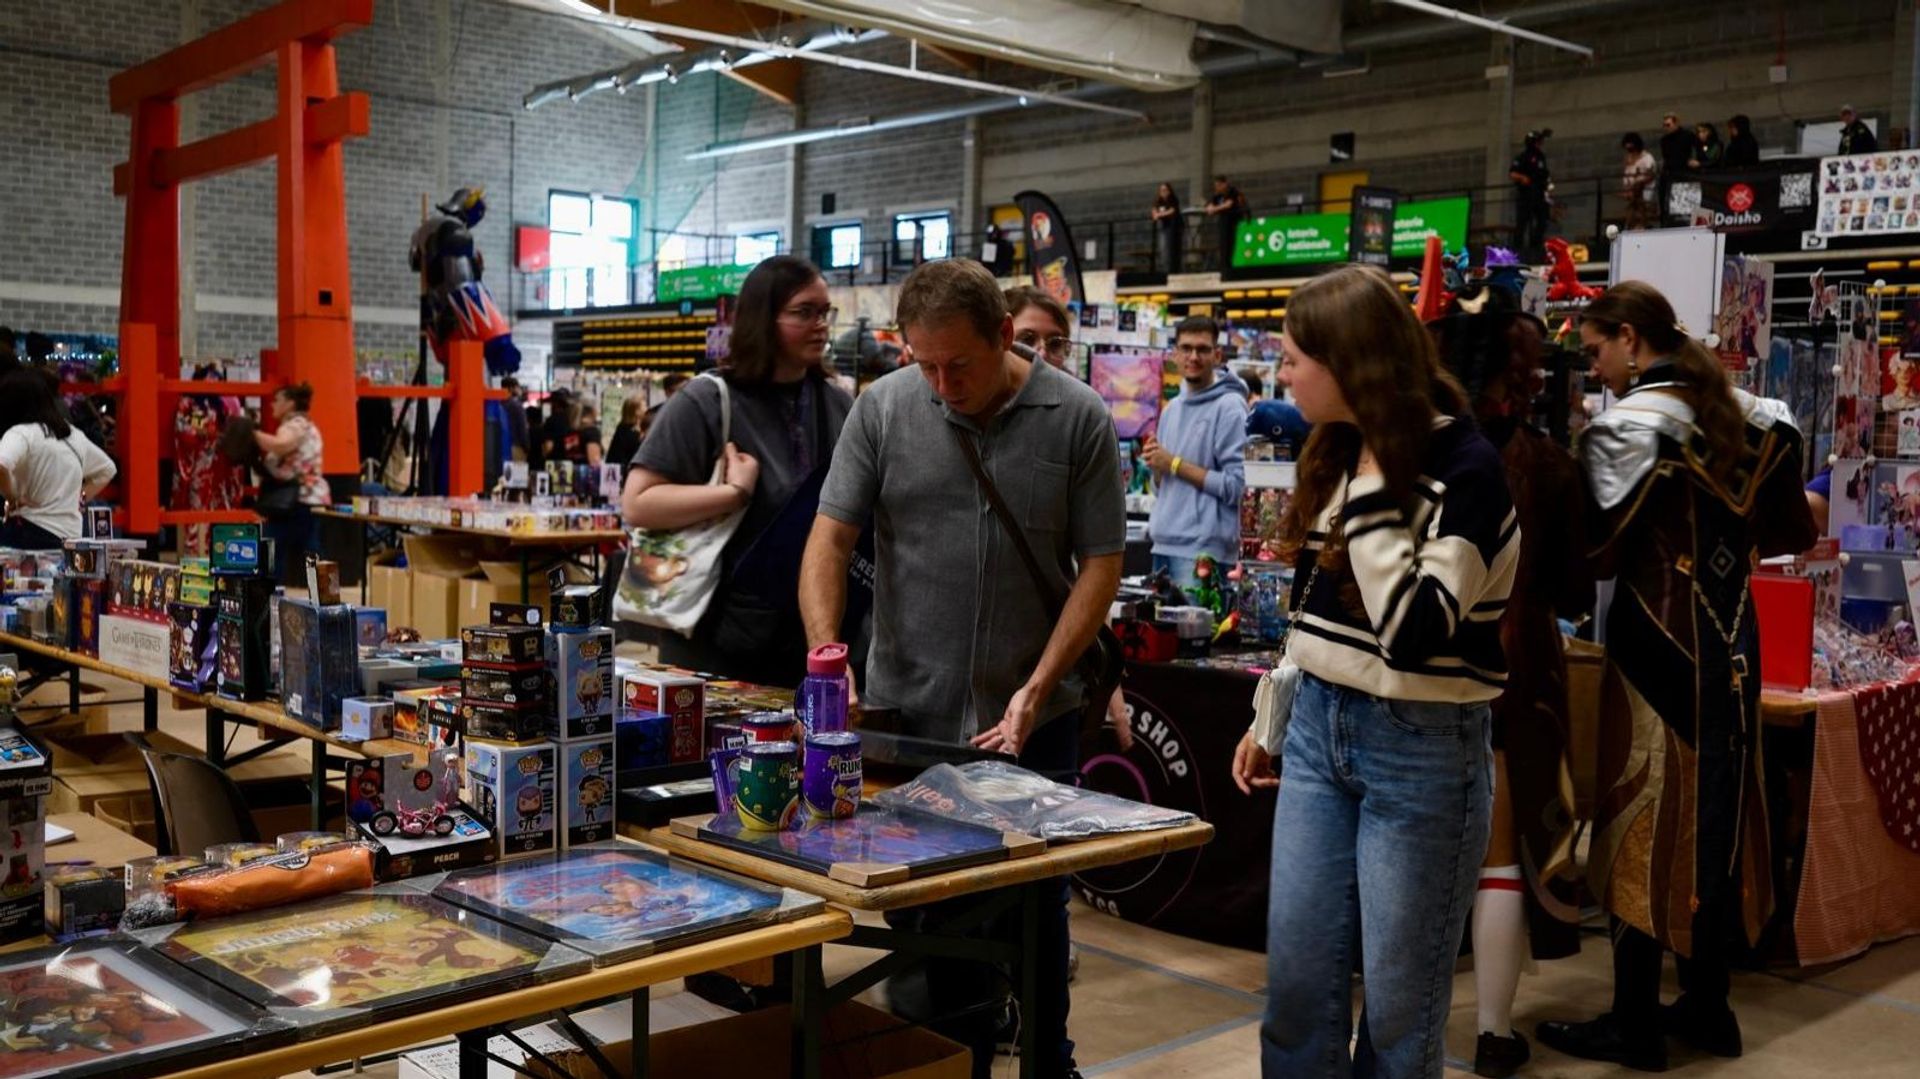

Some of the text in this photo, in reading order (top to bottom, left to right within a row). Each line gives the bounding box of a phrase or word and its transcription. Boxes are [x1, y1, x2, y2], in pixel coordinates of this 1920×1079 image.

[1393, 217, 1424, 230] oterie
[1714, 209, 1762, 227] Daisho
[1136, 710, 1189, 779] SHOP
